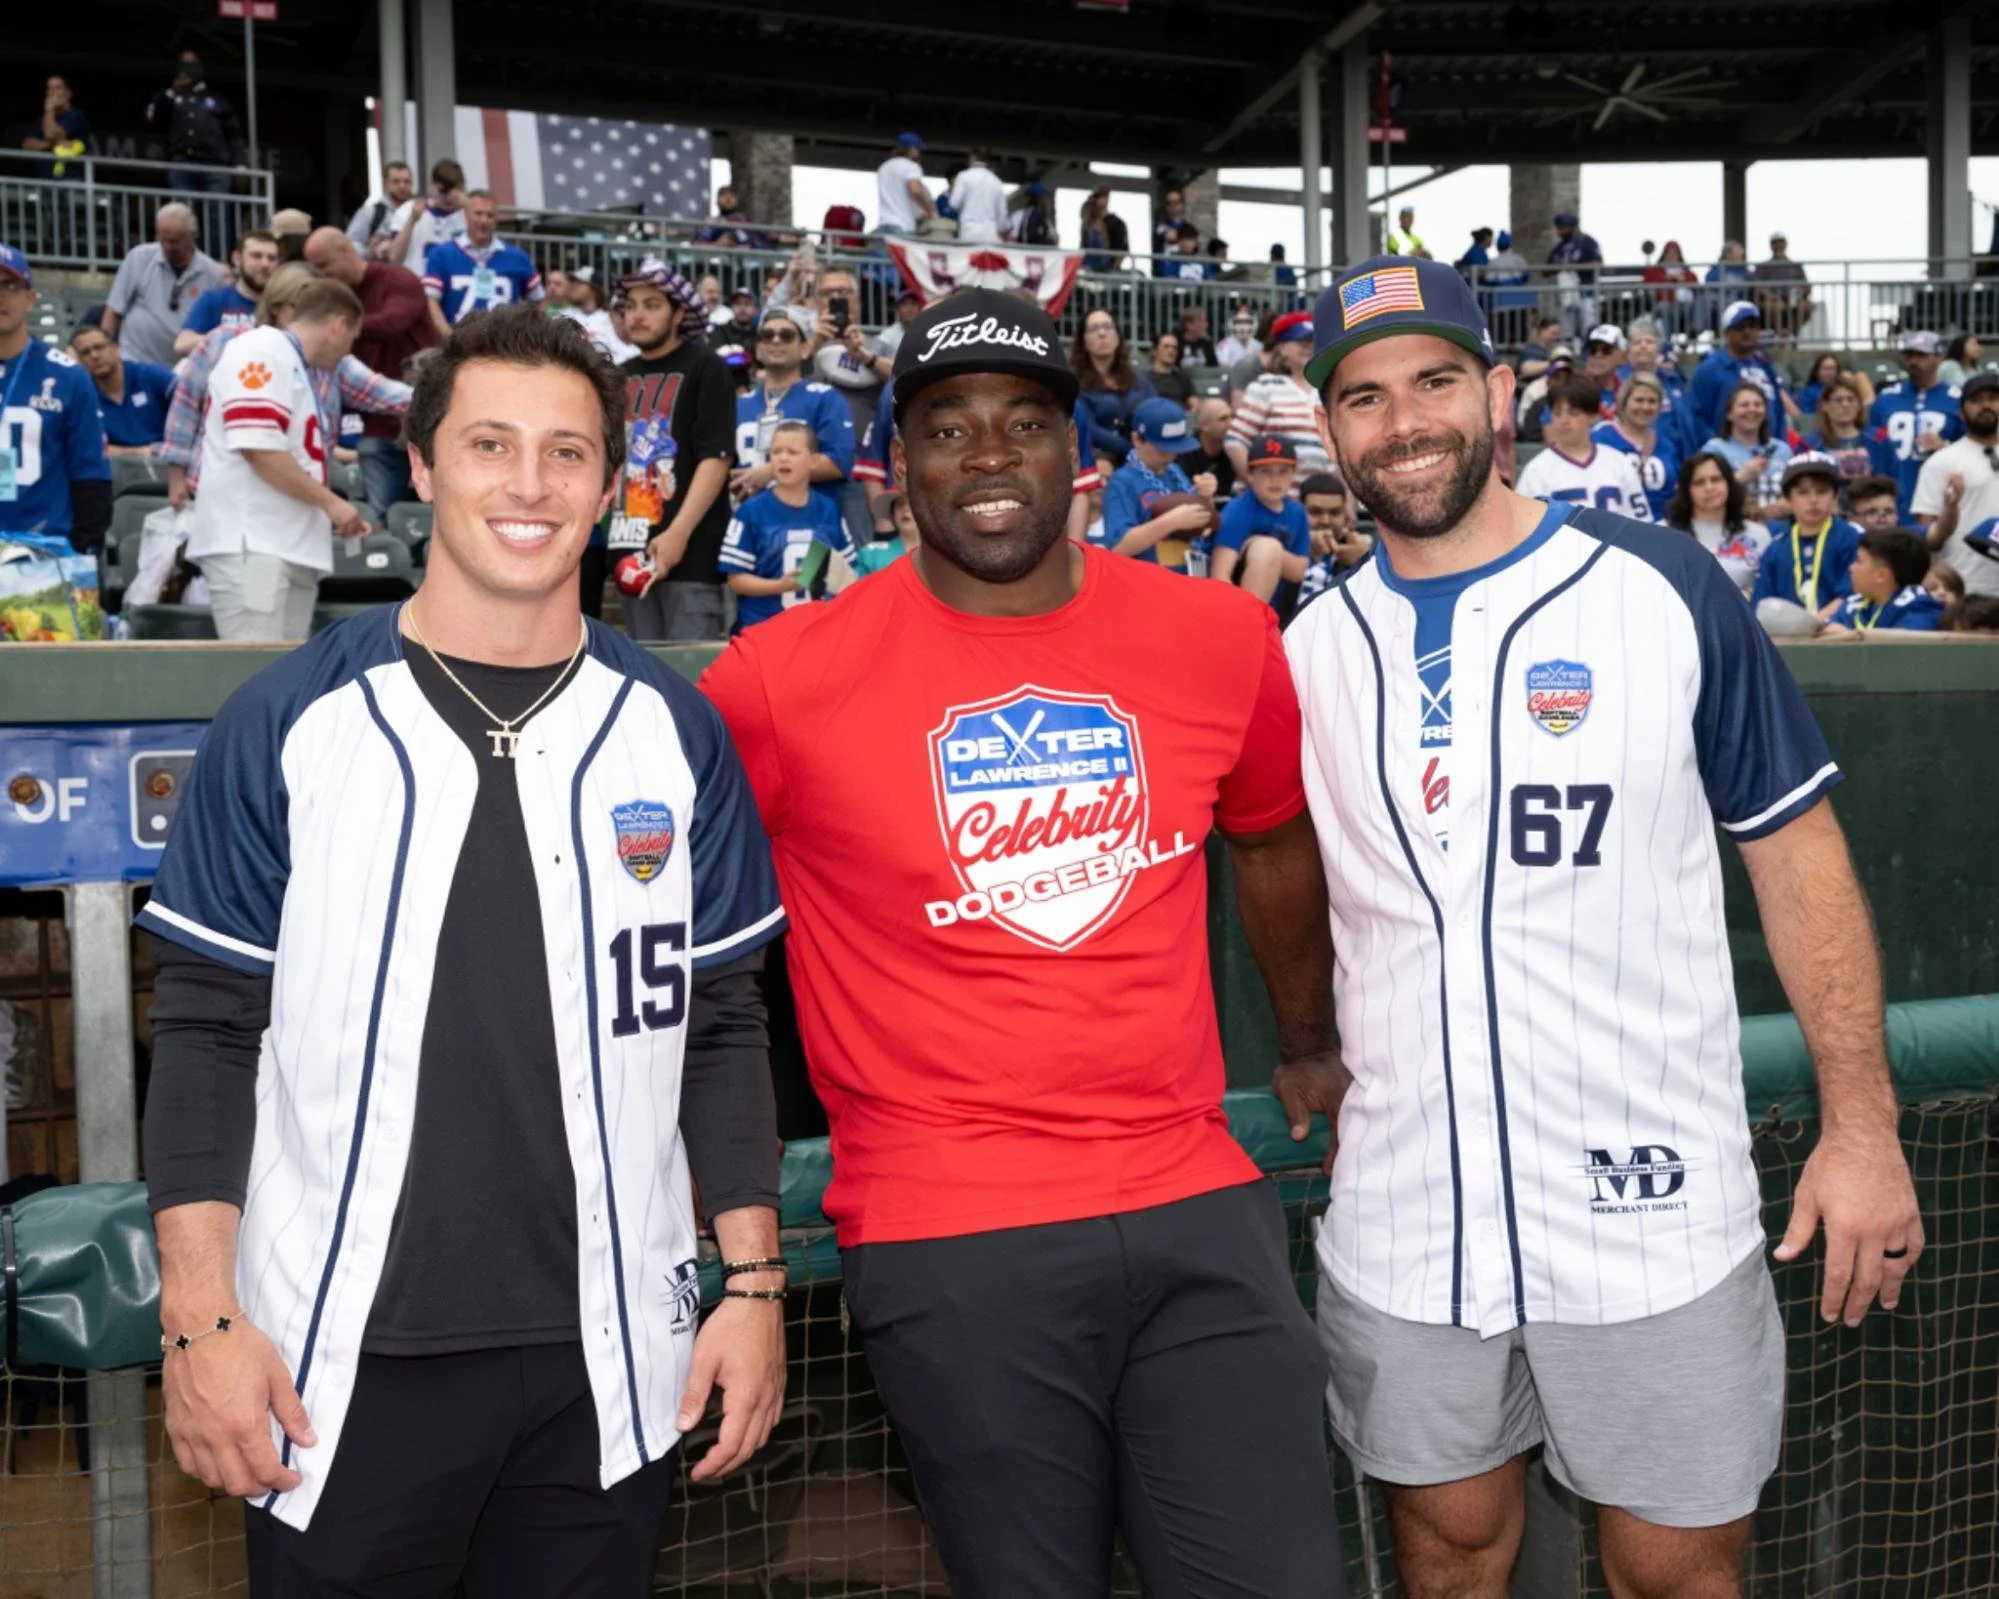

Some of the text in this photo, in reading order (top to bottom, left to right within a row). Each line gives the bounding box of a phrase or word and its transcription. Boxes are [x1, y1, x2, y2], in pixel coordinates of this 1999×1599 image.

[917, 312, 1048, 362] Titleist
[946, 717, 1124, 764] DEXTER
[951, 758, 1109, 787] LAWRENCE
[14, 777, 88, 824] OF
[952, 774, 1146, 866] Celebrity
[1510, 784, 1613, 867] 67
[924, 830, 1196, 928] DODGEBALL
[609, 921, 685, 1038] 15
[1584, 1144, 1685, 1201] MD
[1612, 1165, 1647, 1173] Business
[1650, 1162, 1685, 1171] Funding
[1591, 1201, 1688, 1214] MERCHANT DIRECT
